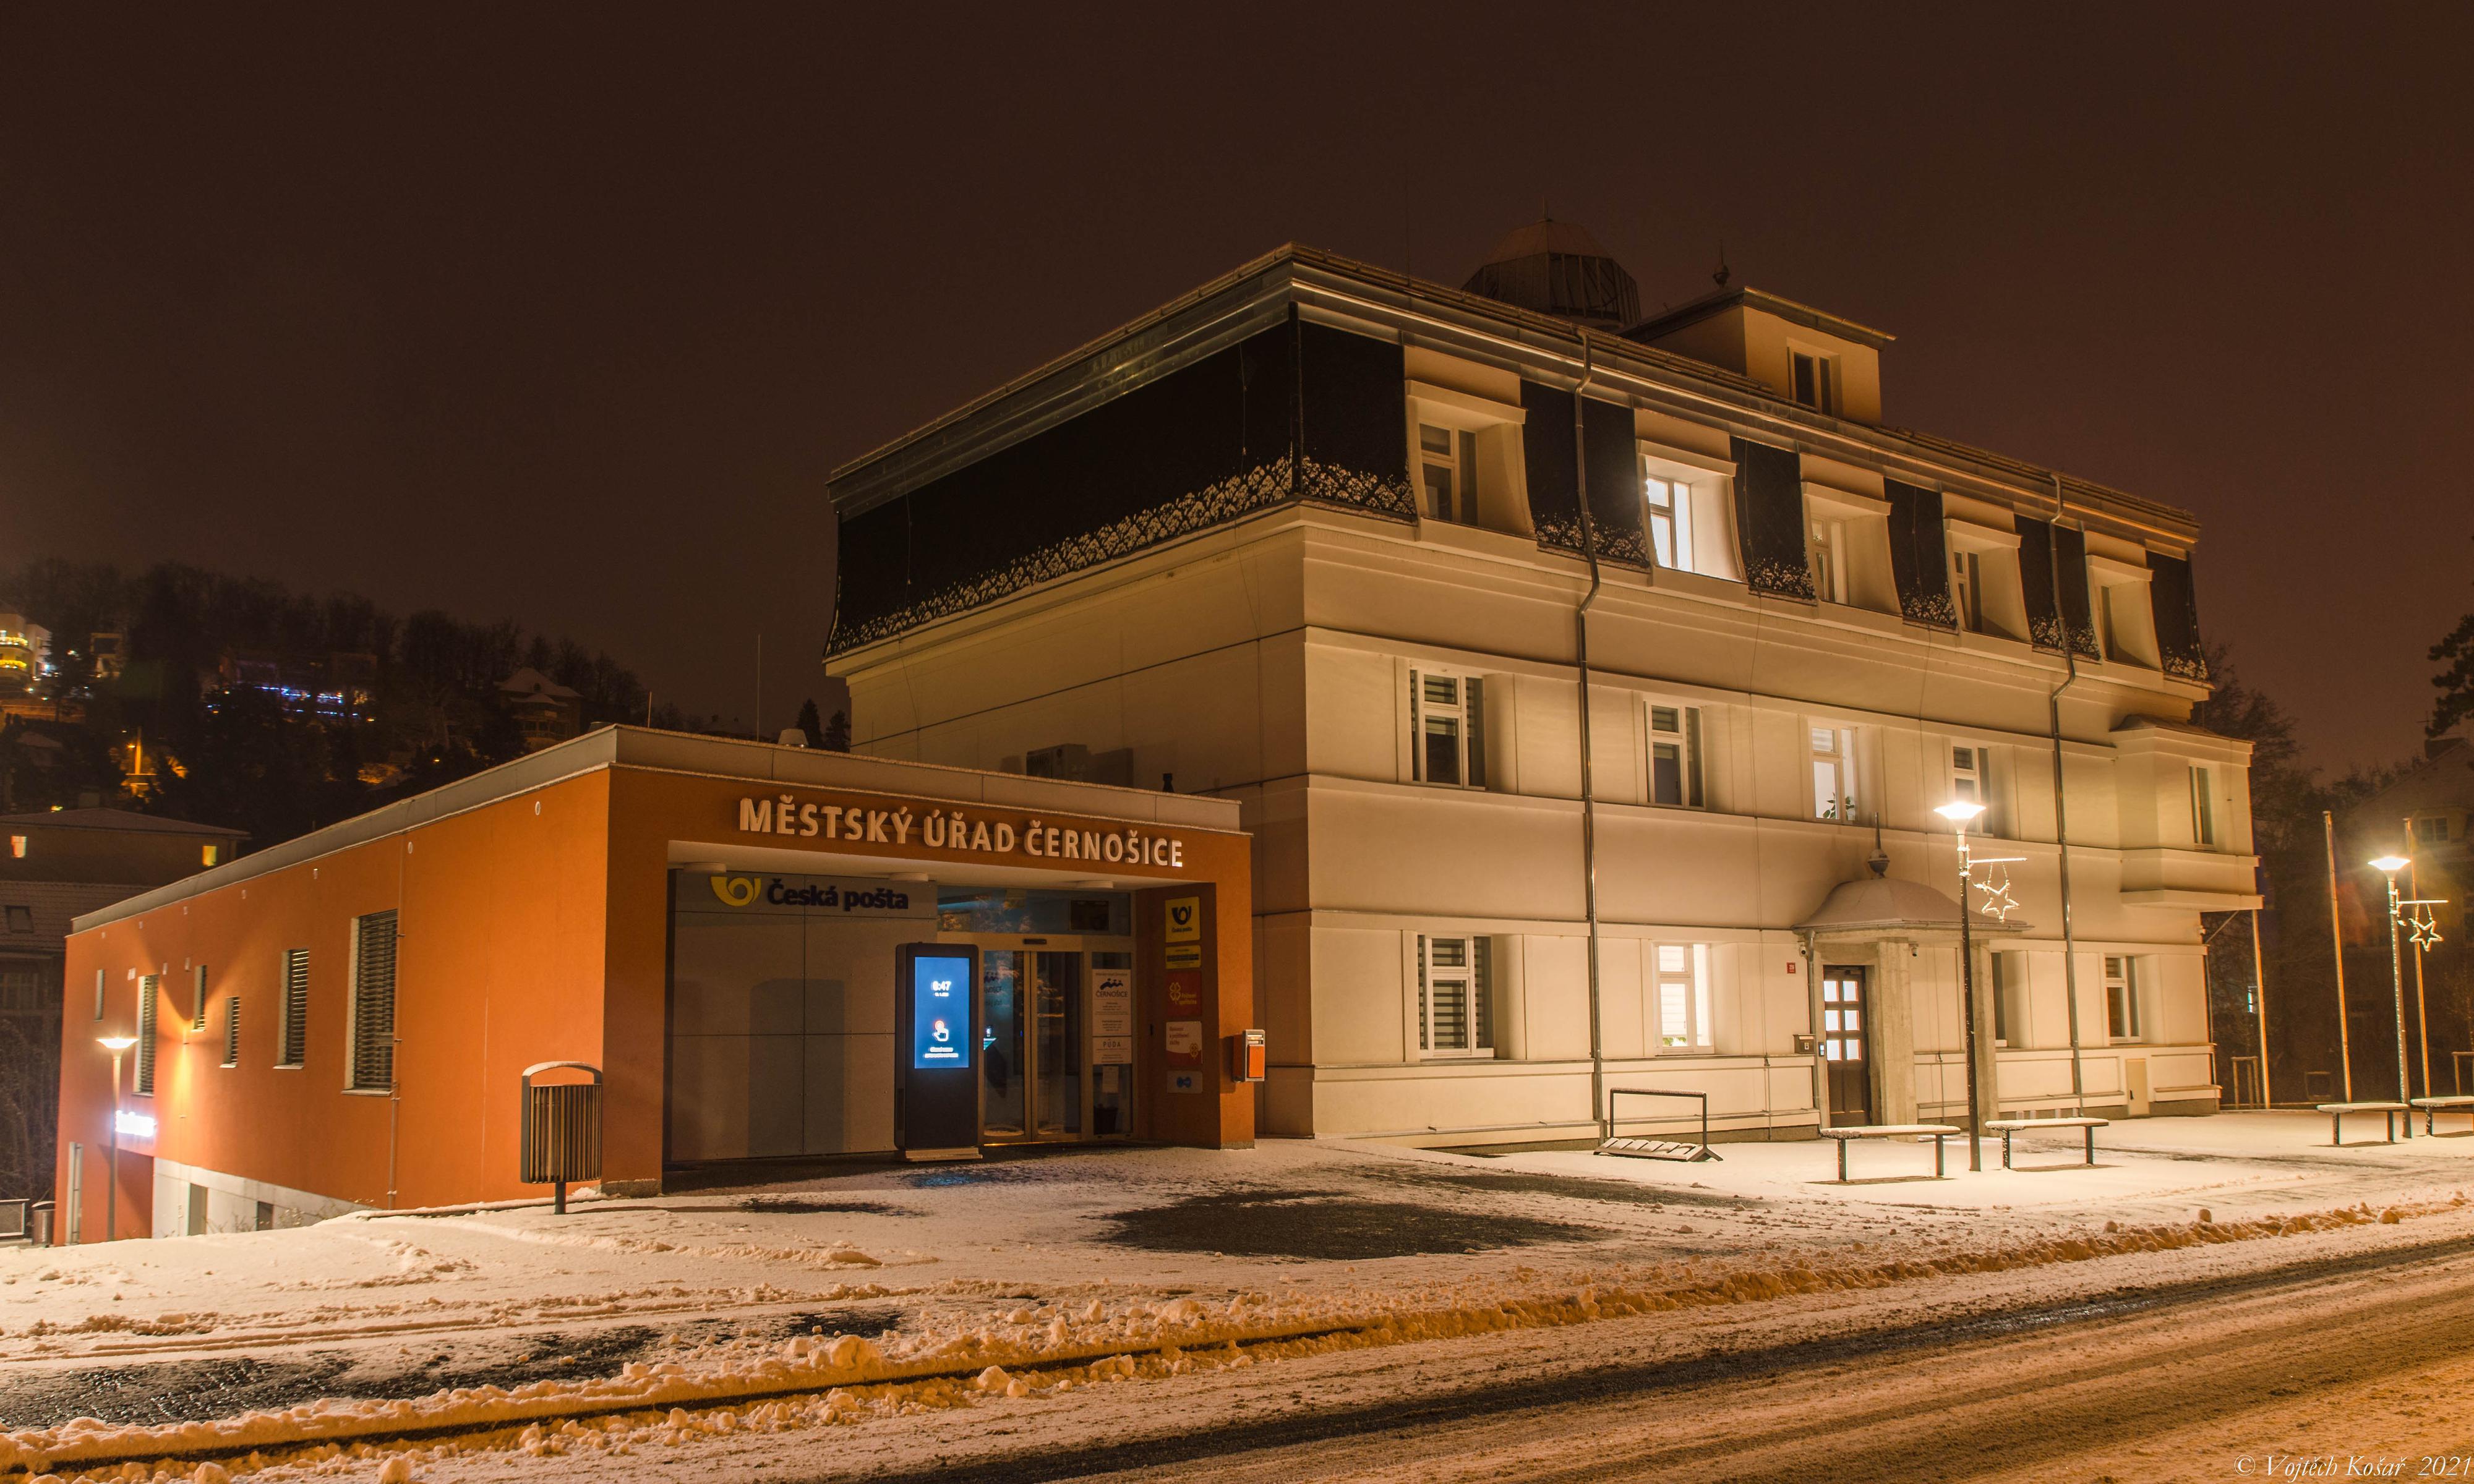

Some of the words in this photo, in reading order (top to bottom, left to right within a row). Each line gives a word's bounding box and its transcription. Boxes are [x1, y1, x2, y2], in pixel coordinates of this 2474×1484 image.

[739, 794, 913, 844] MĚSTSKÝ
[923, 809, 1015, 852] ÚŘAD
[1024, 820, 1183, 868] ČERNOŠICE
[767, 879, 839, 906] Česká
[844, 888, 909, 911] pošta
